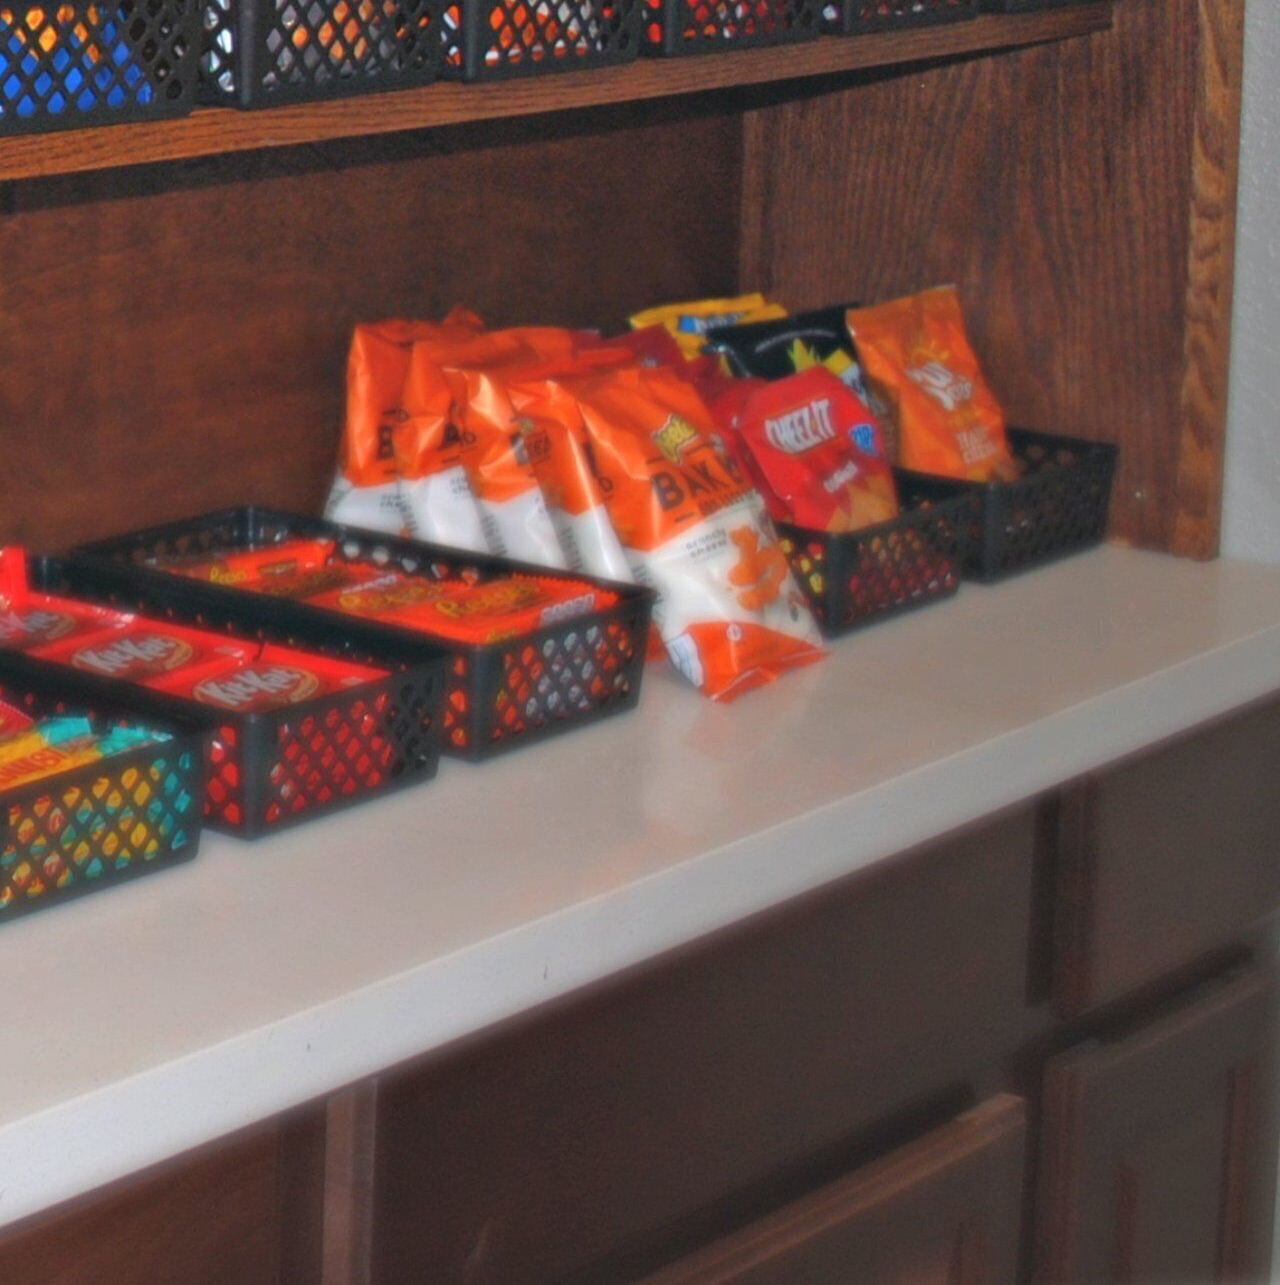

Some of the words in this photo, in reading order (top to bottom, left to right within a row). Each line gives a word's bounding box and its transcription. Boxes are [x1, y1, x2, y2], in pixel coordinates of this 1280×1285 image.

[79, 638, 135, 672] Kit
[130, 636, 177, 662] Kat
[199, 671, 251, 705] Kit
[247, 667, 303, 702] Kat
